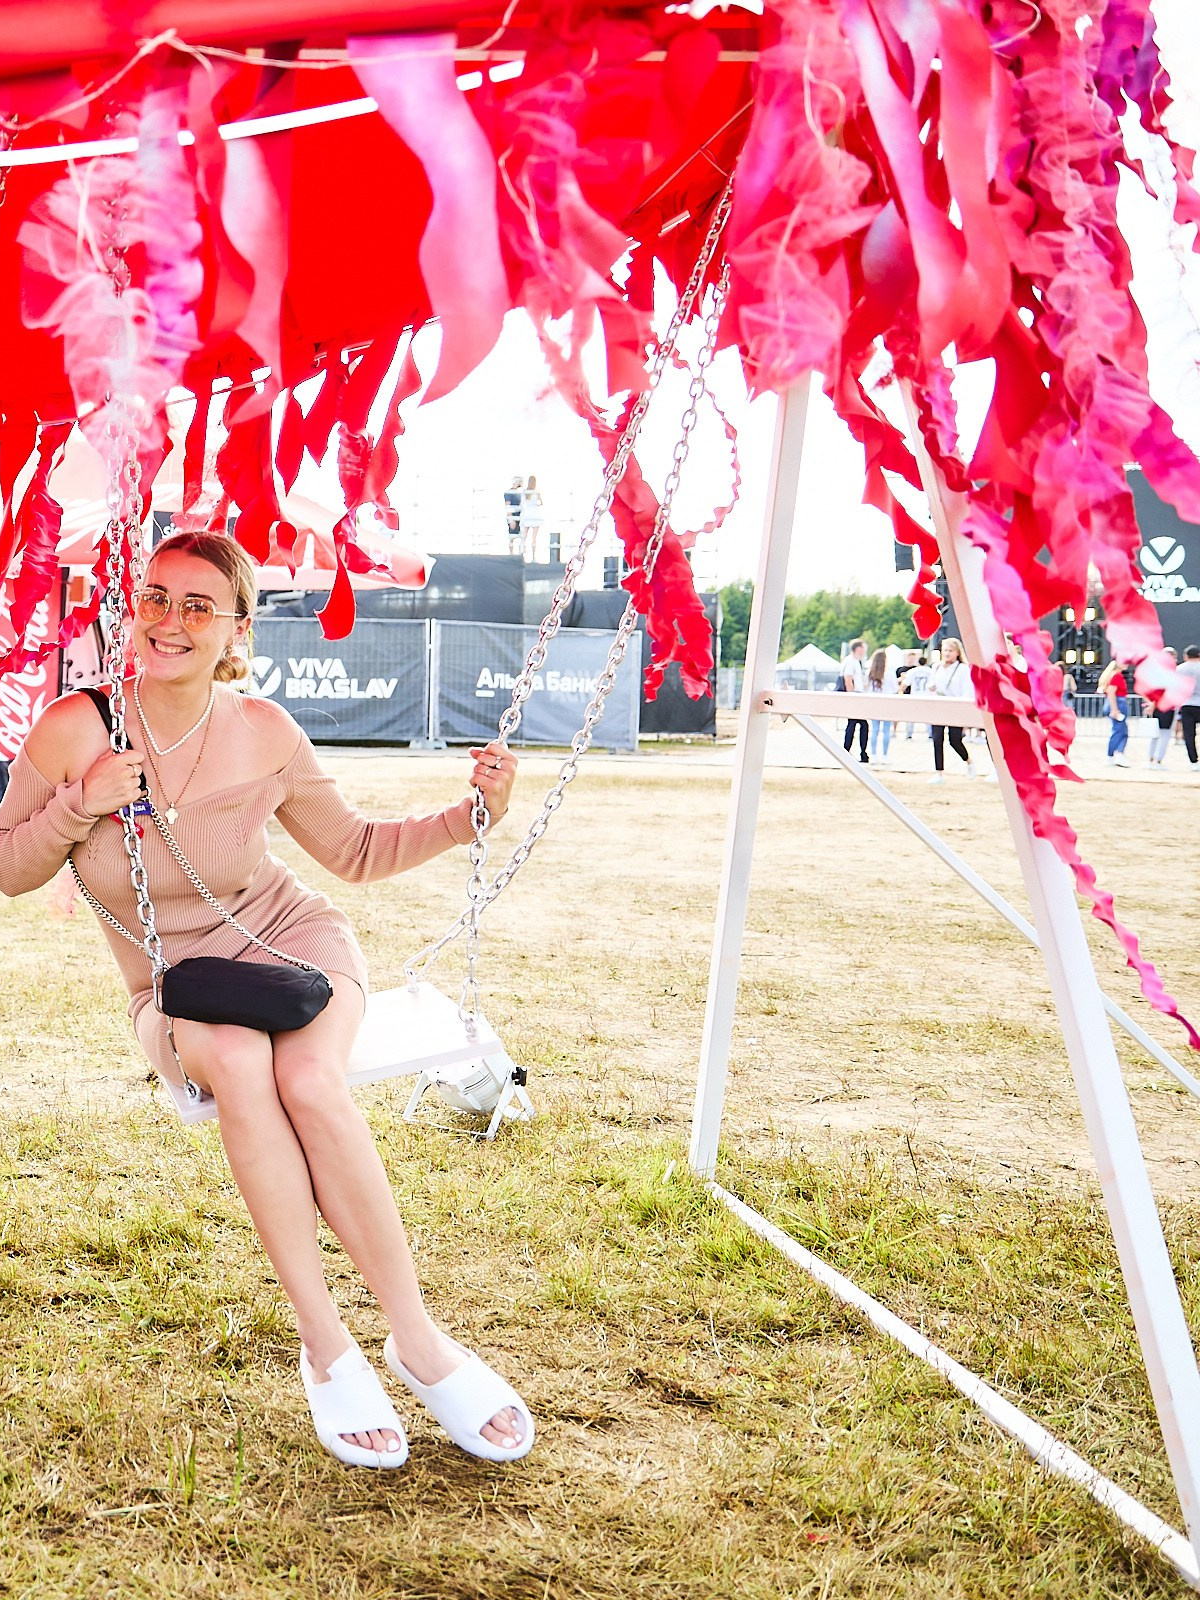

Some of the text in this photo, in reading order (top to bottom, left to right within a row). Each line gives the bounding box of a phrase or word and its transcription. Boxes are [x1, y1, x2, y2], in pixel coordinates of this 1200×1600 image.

[287, 657, 348, 678] VIVA
[285, 678, 399, 698] BRASLAV
[476, 667, 545, 694] Альа
